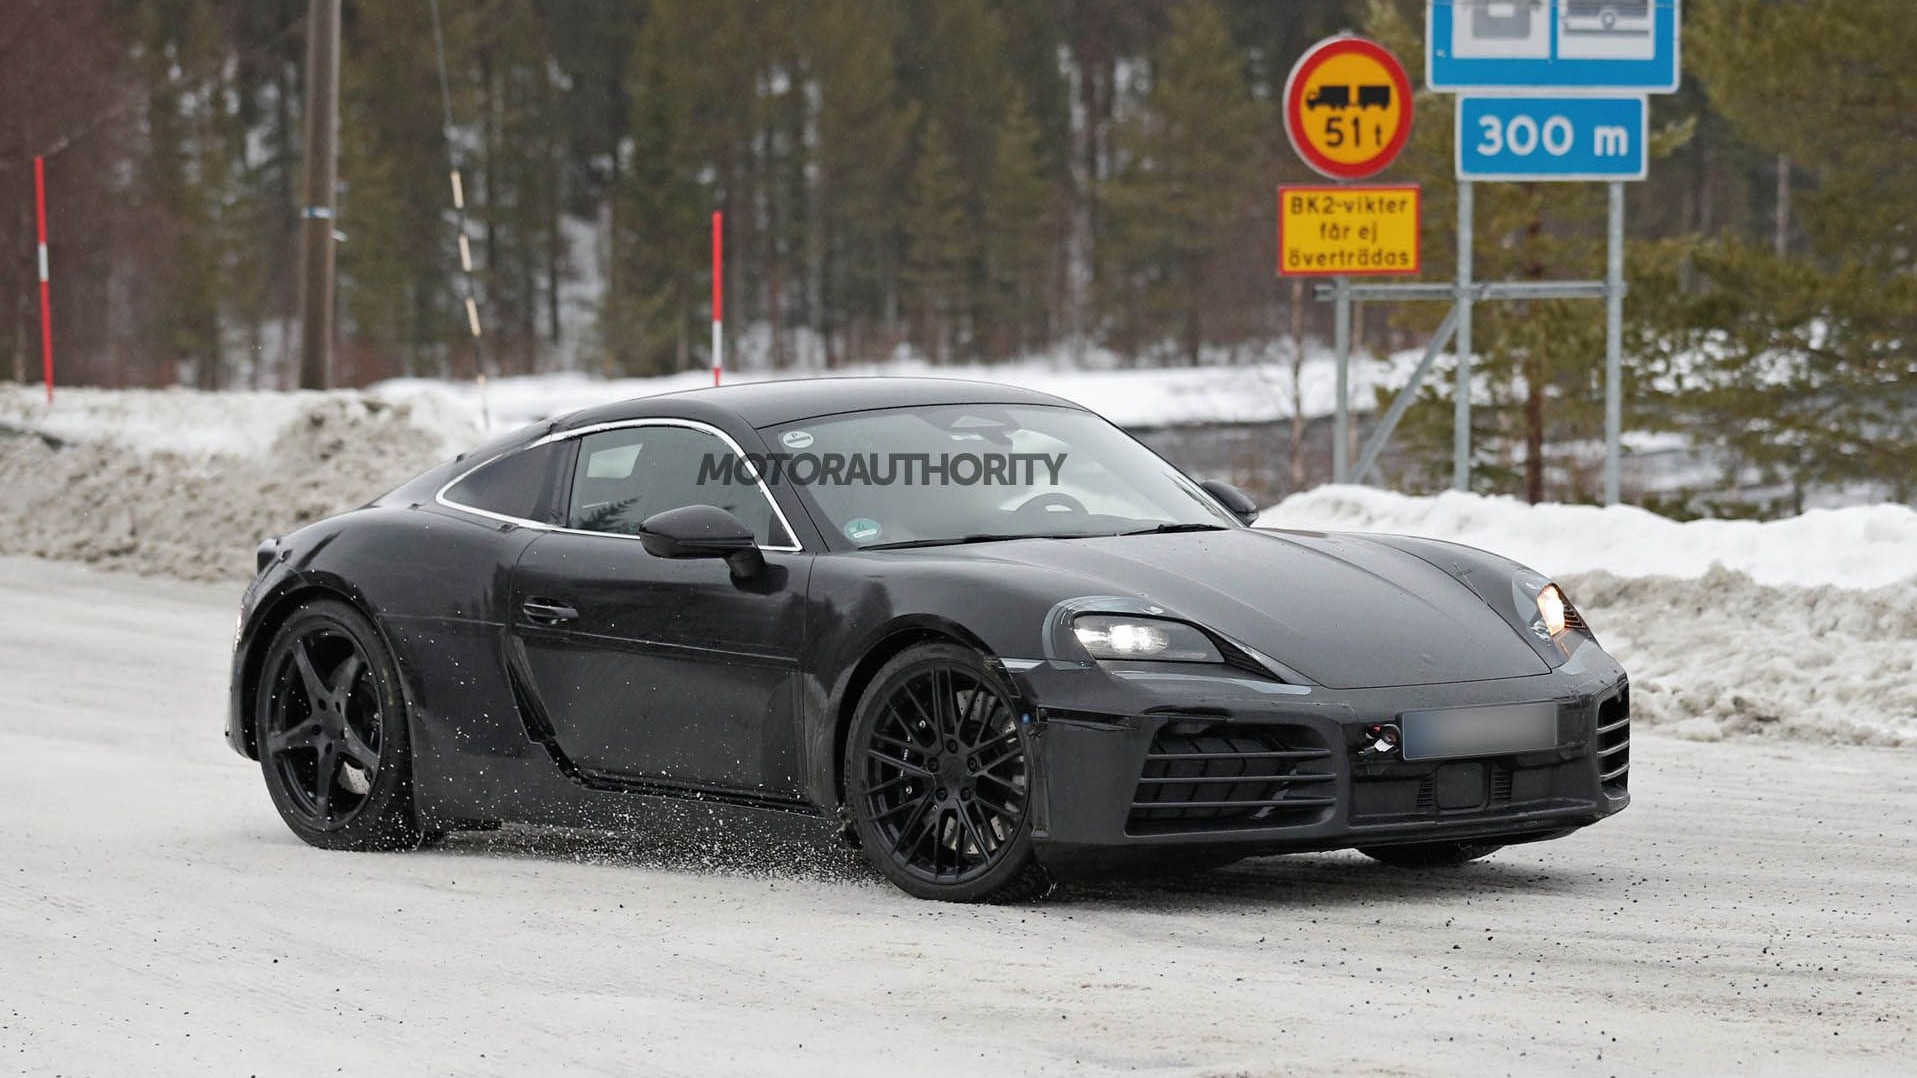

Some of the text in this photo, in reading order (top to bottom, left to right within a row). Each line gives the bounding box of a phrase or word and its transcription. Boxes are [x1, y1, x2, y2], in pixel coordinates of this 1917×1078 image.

[1325, 117, 1383, 147] 51 t
[1476, 115, 1628, 156] 300 m
[1291, 195, 1408, 214] BK2-vikter
[1320, 220, 1378, 244] får ej
[1287, 248, 1410, 268] överträdas
